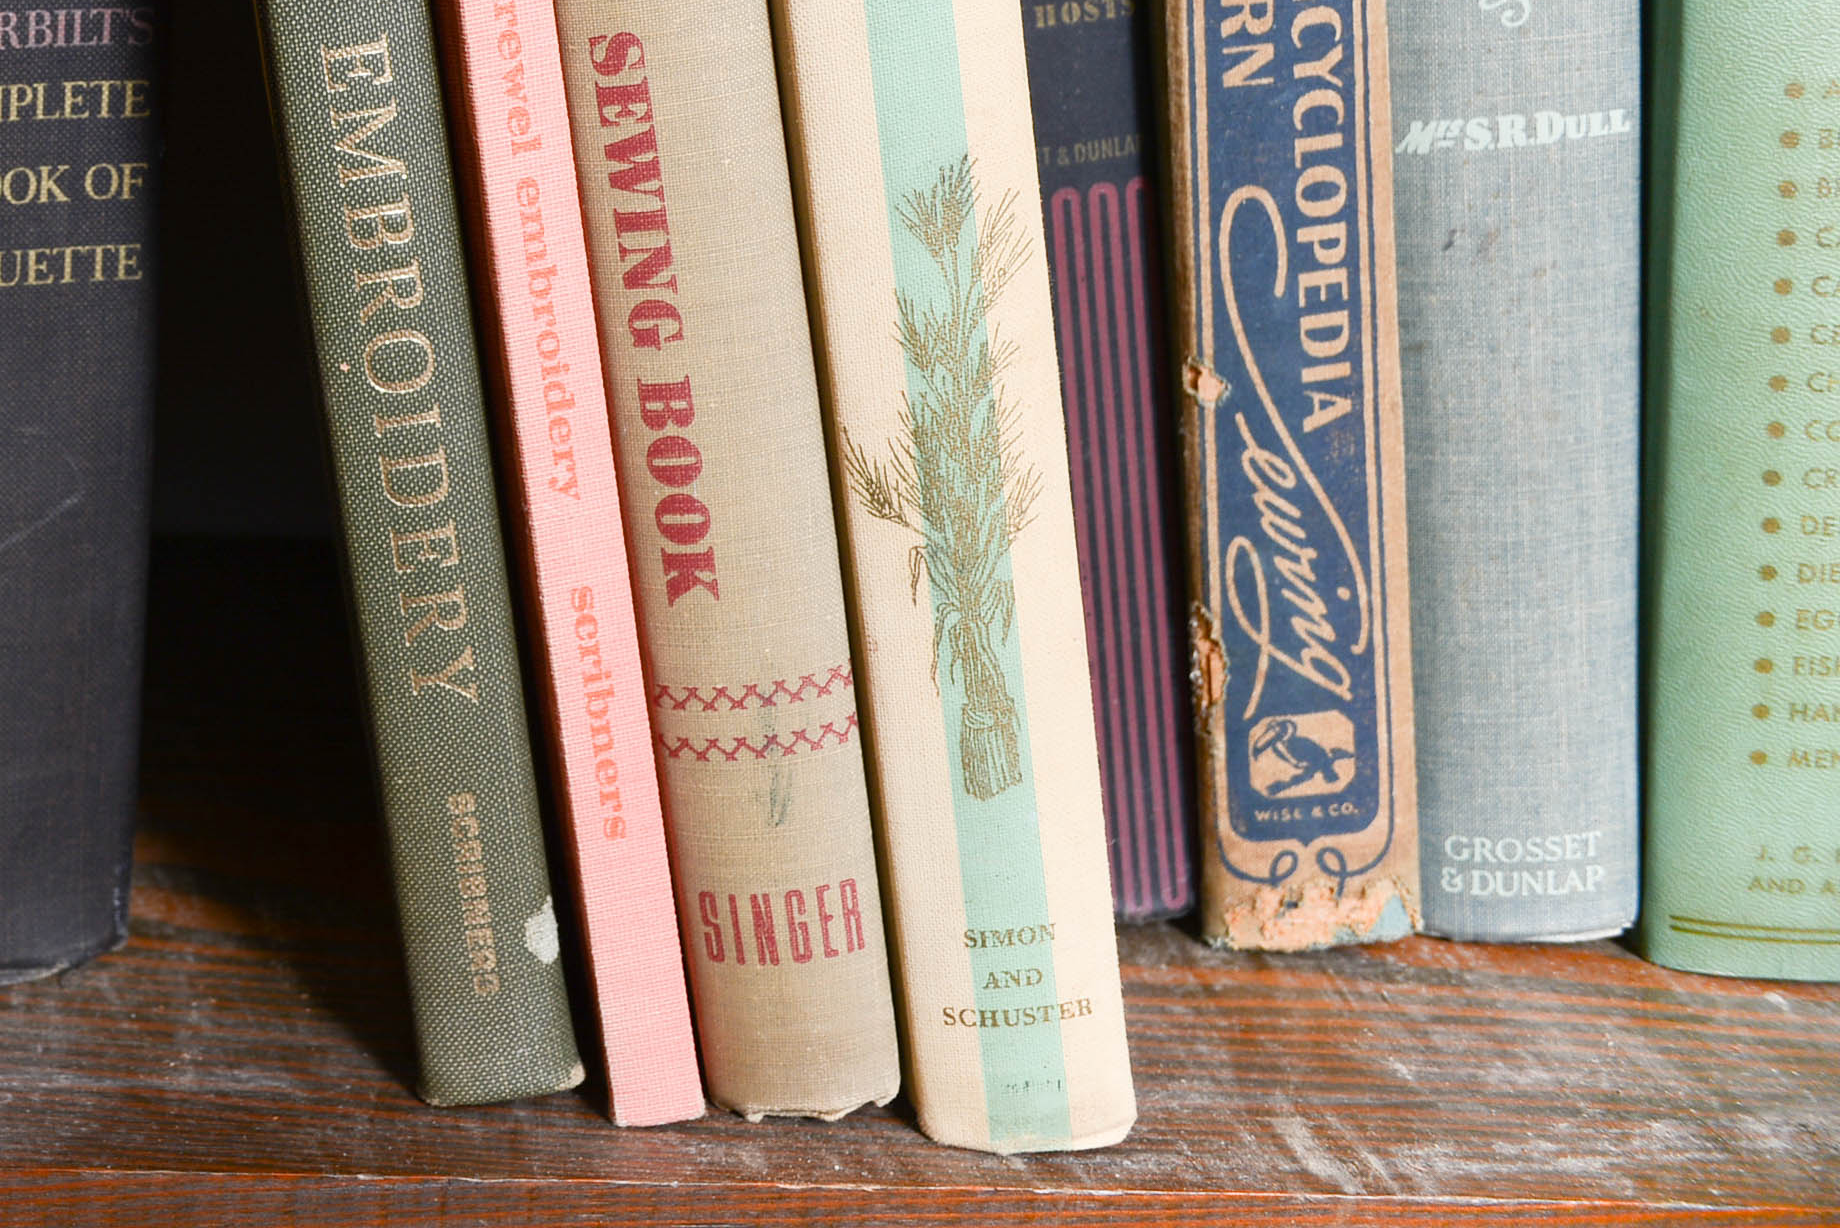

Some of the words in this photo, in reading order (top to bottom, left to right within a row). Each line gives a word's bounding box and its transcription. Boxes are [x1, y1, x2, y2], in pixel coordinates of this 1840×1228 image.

[85, 162, 148, 202] OF
[588, 30, 685, 351] SEWING
[322, 32, 479, 704] EMBROIDERY
[516, 176, 581, 501] embroidery
[636, 374, 720, 608] BOOK
[1218, 183, 1370, 720] Sewing
[570, 586, 626, 841] scribners
[1254, 806, 1302, 821] WISE
[1328, 801, 1359, 816] CO.
[1444, 831, 1601, 863] GROSSET
[448, 792, 500, 996] SCRIBNERS
[698, 878, 865, 966] SINGER
[1441, 866, 1464, 893] &
[1470, 865, 1605, 897] DUNLAP
[963, 923, 1056, 949] SIMON
[983, 968, 1043, 990] AND
[943, 998, 1093, 1028] SCHUSTER
